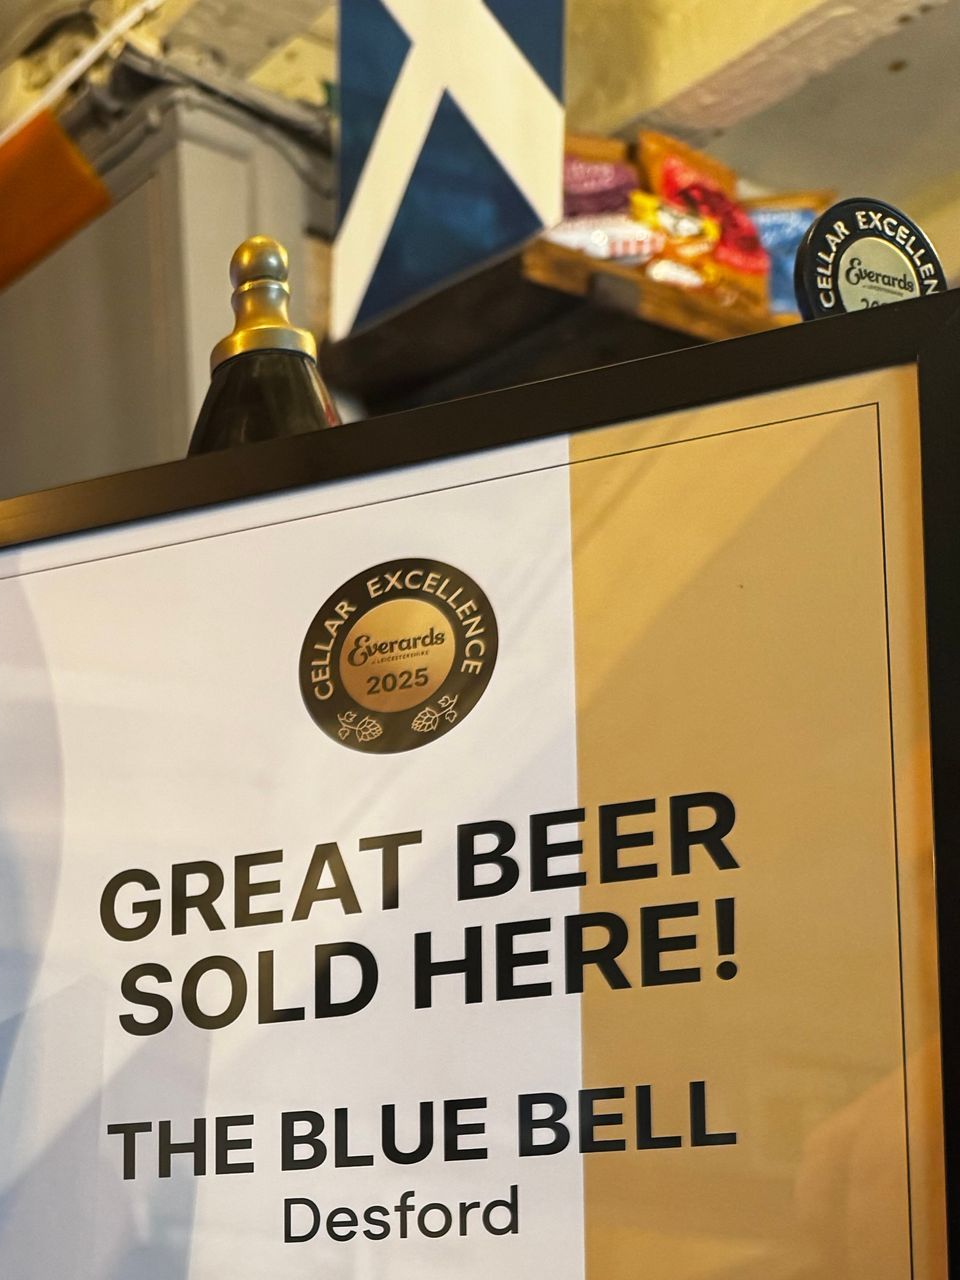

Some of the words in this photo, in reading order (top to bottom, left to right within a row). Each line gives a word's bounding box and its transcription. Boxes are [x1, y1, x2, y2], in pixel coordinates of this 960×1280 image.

[817, 221, 851, 308] CELLAR
[855, 211, 939, 295] EXCELLEN
[845, 257, 914, 293] Everards
[311, 600, 358, 700] CELLAR
[367, 570, 486, 675] EXCELLENCE
[347, 627, 445, 667] Everards
[367, 667, 429, 695] 2025
[99, 830, 422, 942] GREAT
[456, 791, 741, 902] BEER
[119, 941, 379, 1036] SOLD
[414, 897, 738, 1010] HERE!
[107, 1114, 254, 1180] THE
[281, 1097, 487, 1171] BLUE
[518, 1081, 737, 1158] BELL
[283, 1185, 520, 1244] Desford
